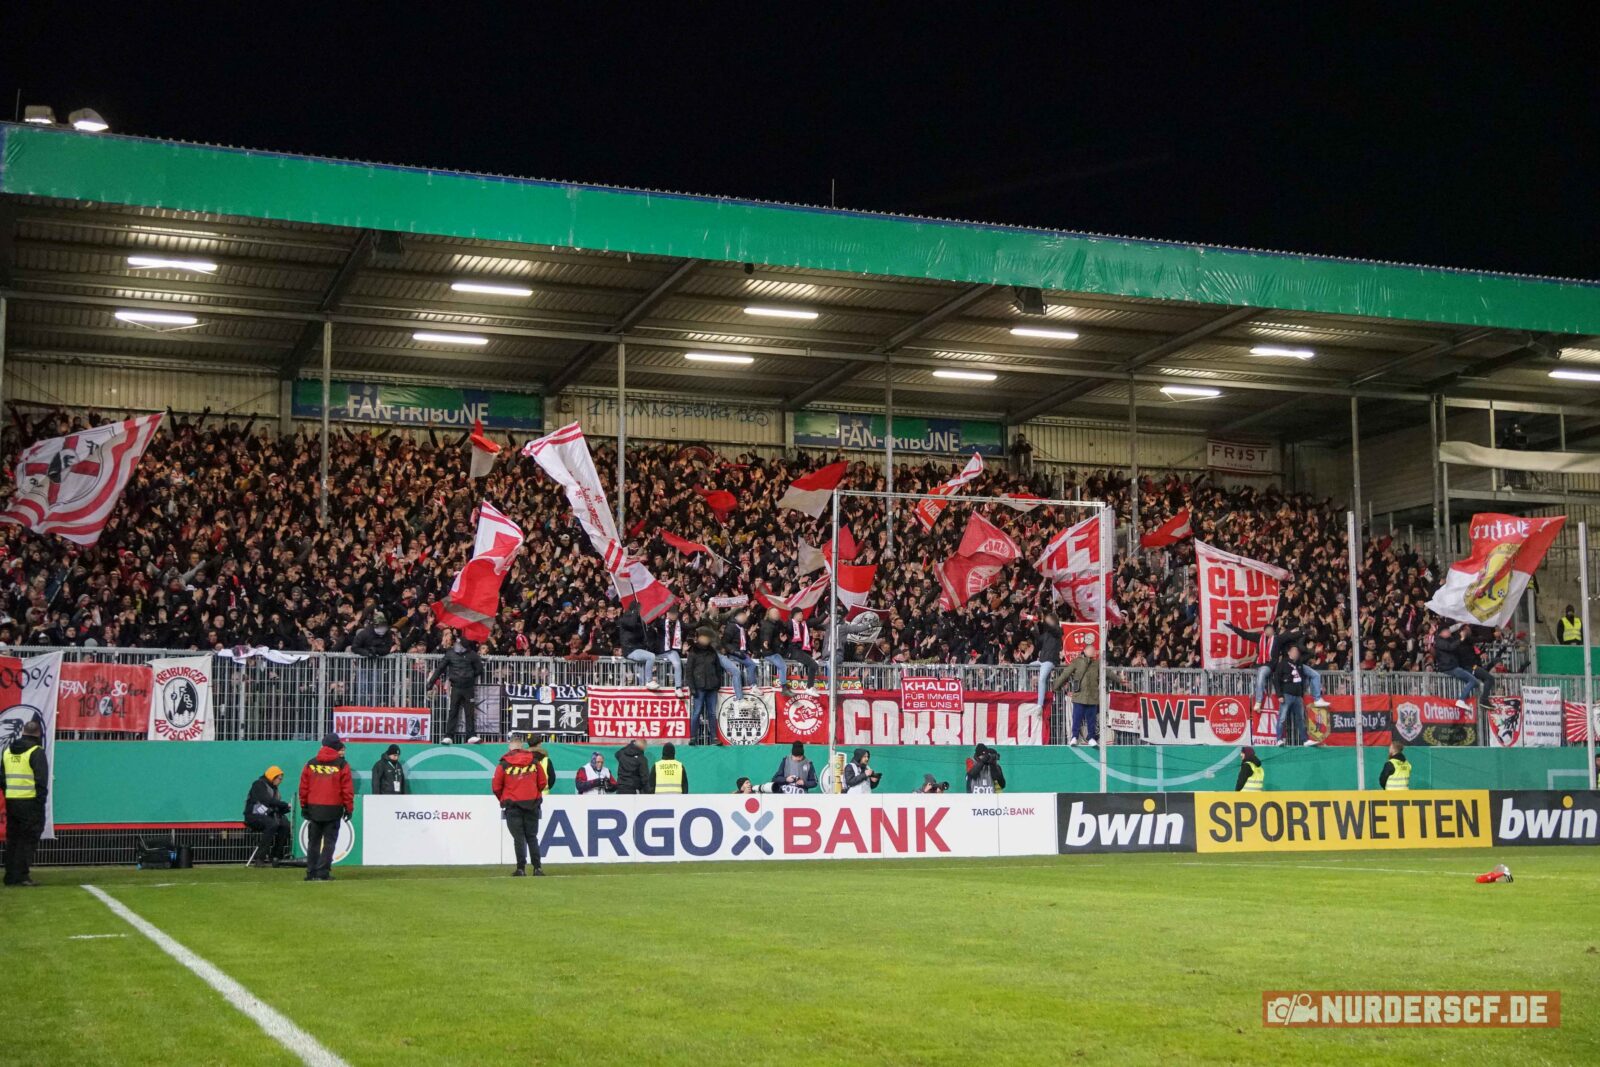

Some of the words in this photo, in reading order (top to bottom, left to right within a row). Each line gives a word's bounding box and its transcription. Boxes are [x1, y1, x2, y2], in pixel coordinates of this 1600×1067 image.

[156, 666, 208, 686] FREIBURGER
[905, 681, 959, 692] KHALID
[905, 691, 924, 700] FÜR
[927, 693, 959, 701] IMMER
[590, 699, 688, 717] SYNTHESIA
[930, 701, 952, 709] UNS
[593, 720, 661, 737] ULTRAS
[666, 720, 686, 737] 79
[1140, 697, 1206, 740] IWF
[154, 719, 206, 741] BOTSCHAFT
[1065, 798, 1184, 846] bwin
[1209, 799, 1480, 843] SPORTWETTEN
[1498, 795, 1597, 840] bwin
